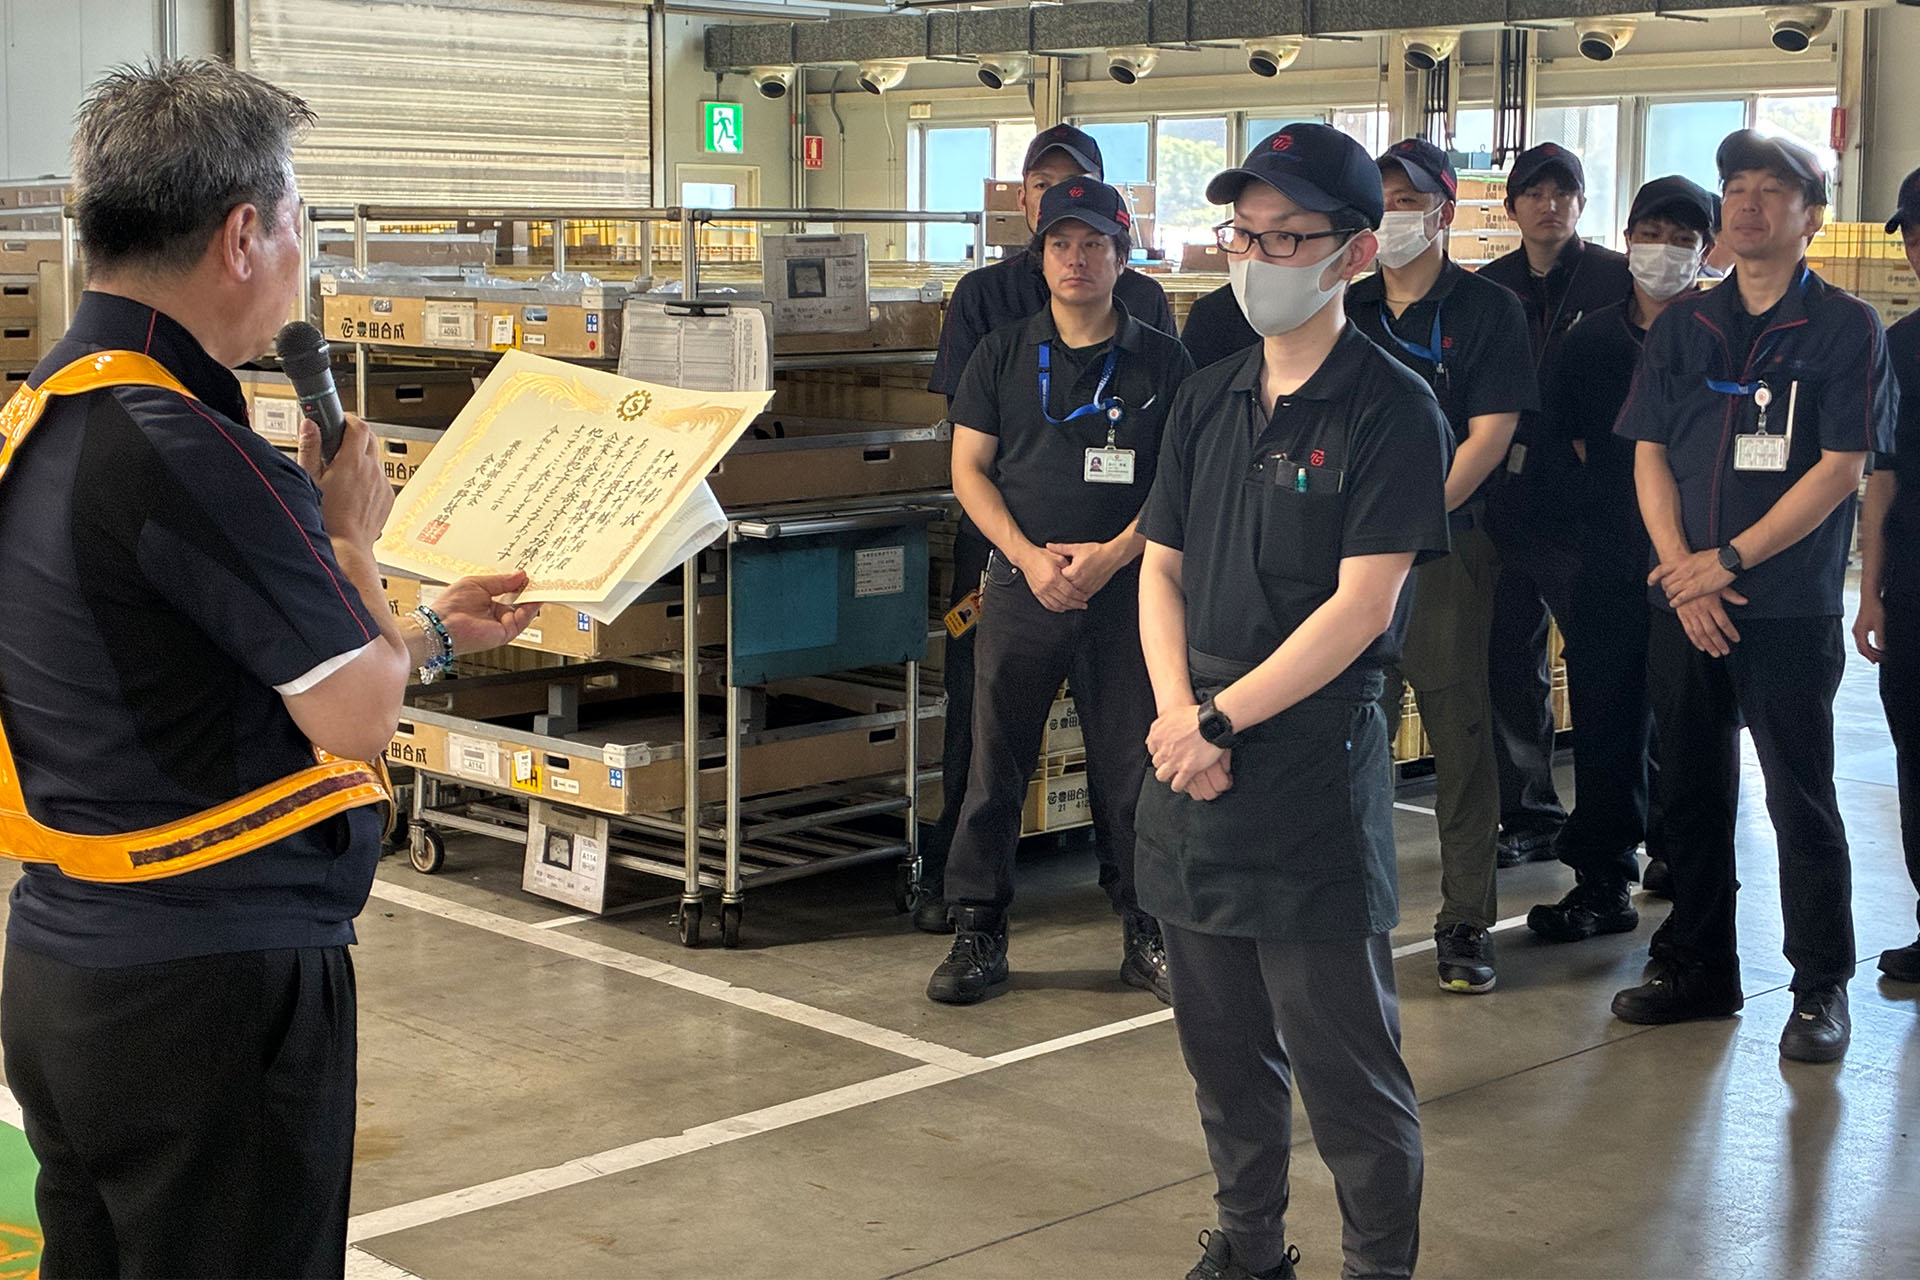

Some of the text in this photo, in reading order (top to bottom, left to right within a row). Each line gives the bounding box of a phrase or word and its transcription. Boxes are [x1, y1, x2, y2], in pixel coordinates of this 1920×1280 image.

[356, 321, 405, 340] 豊田合成
[385, 742, 427, 765] 田合成
